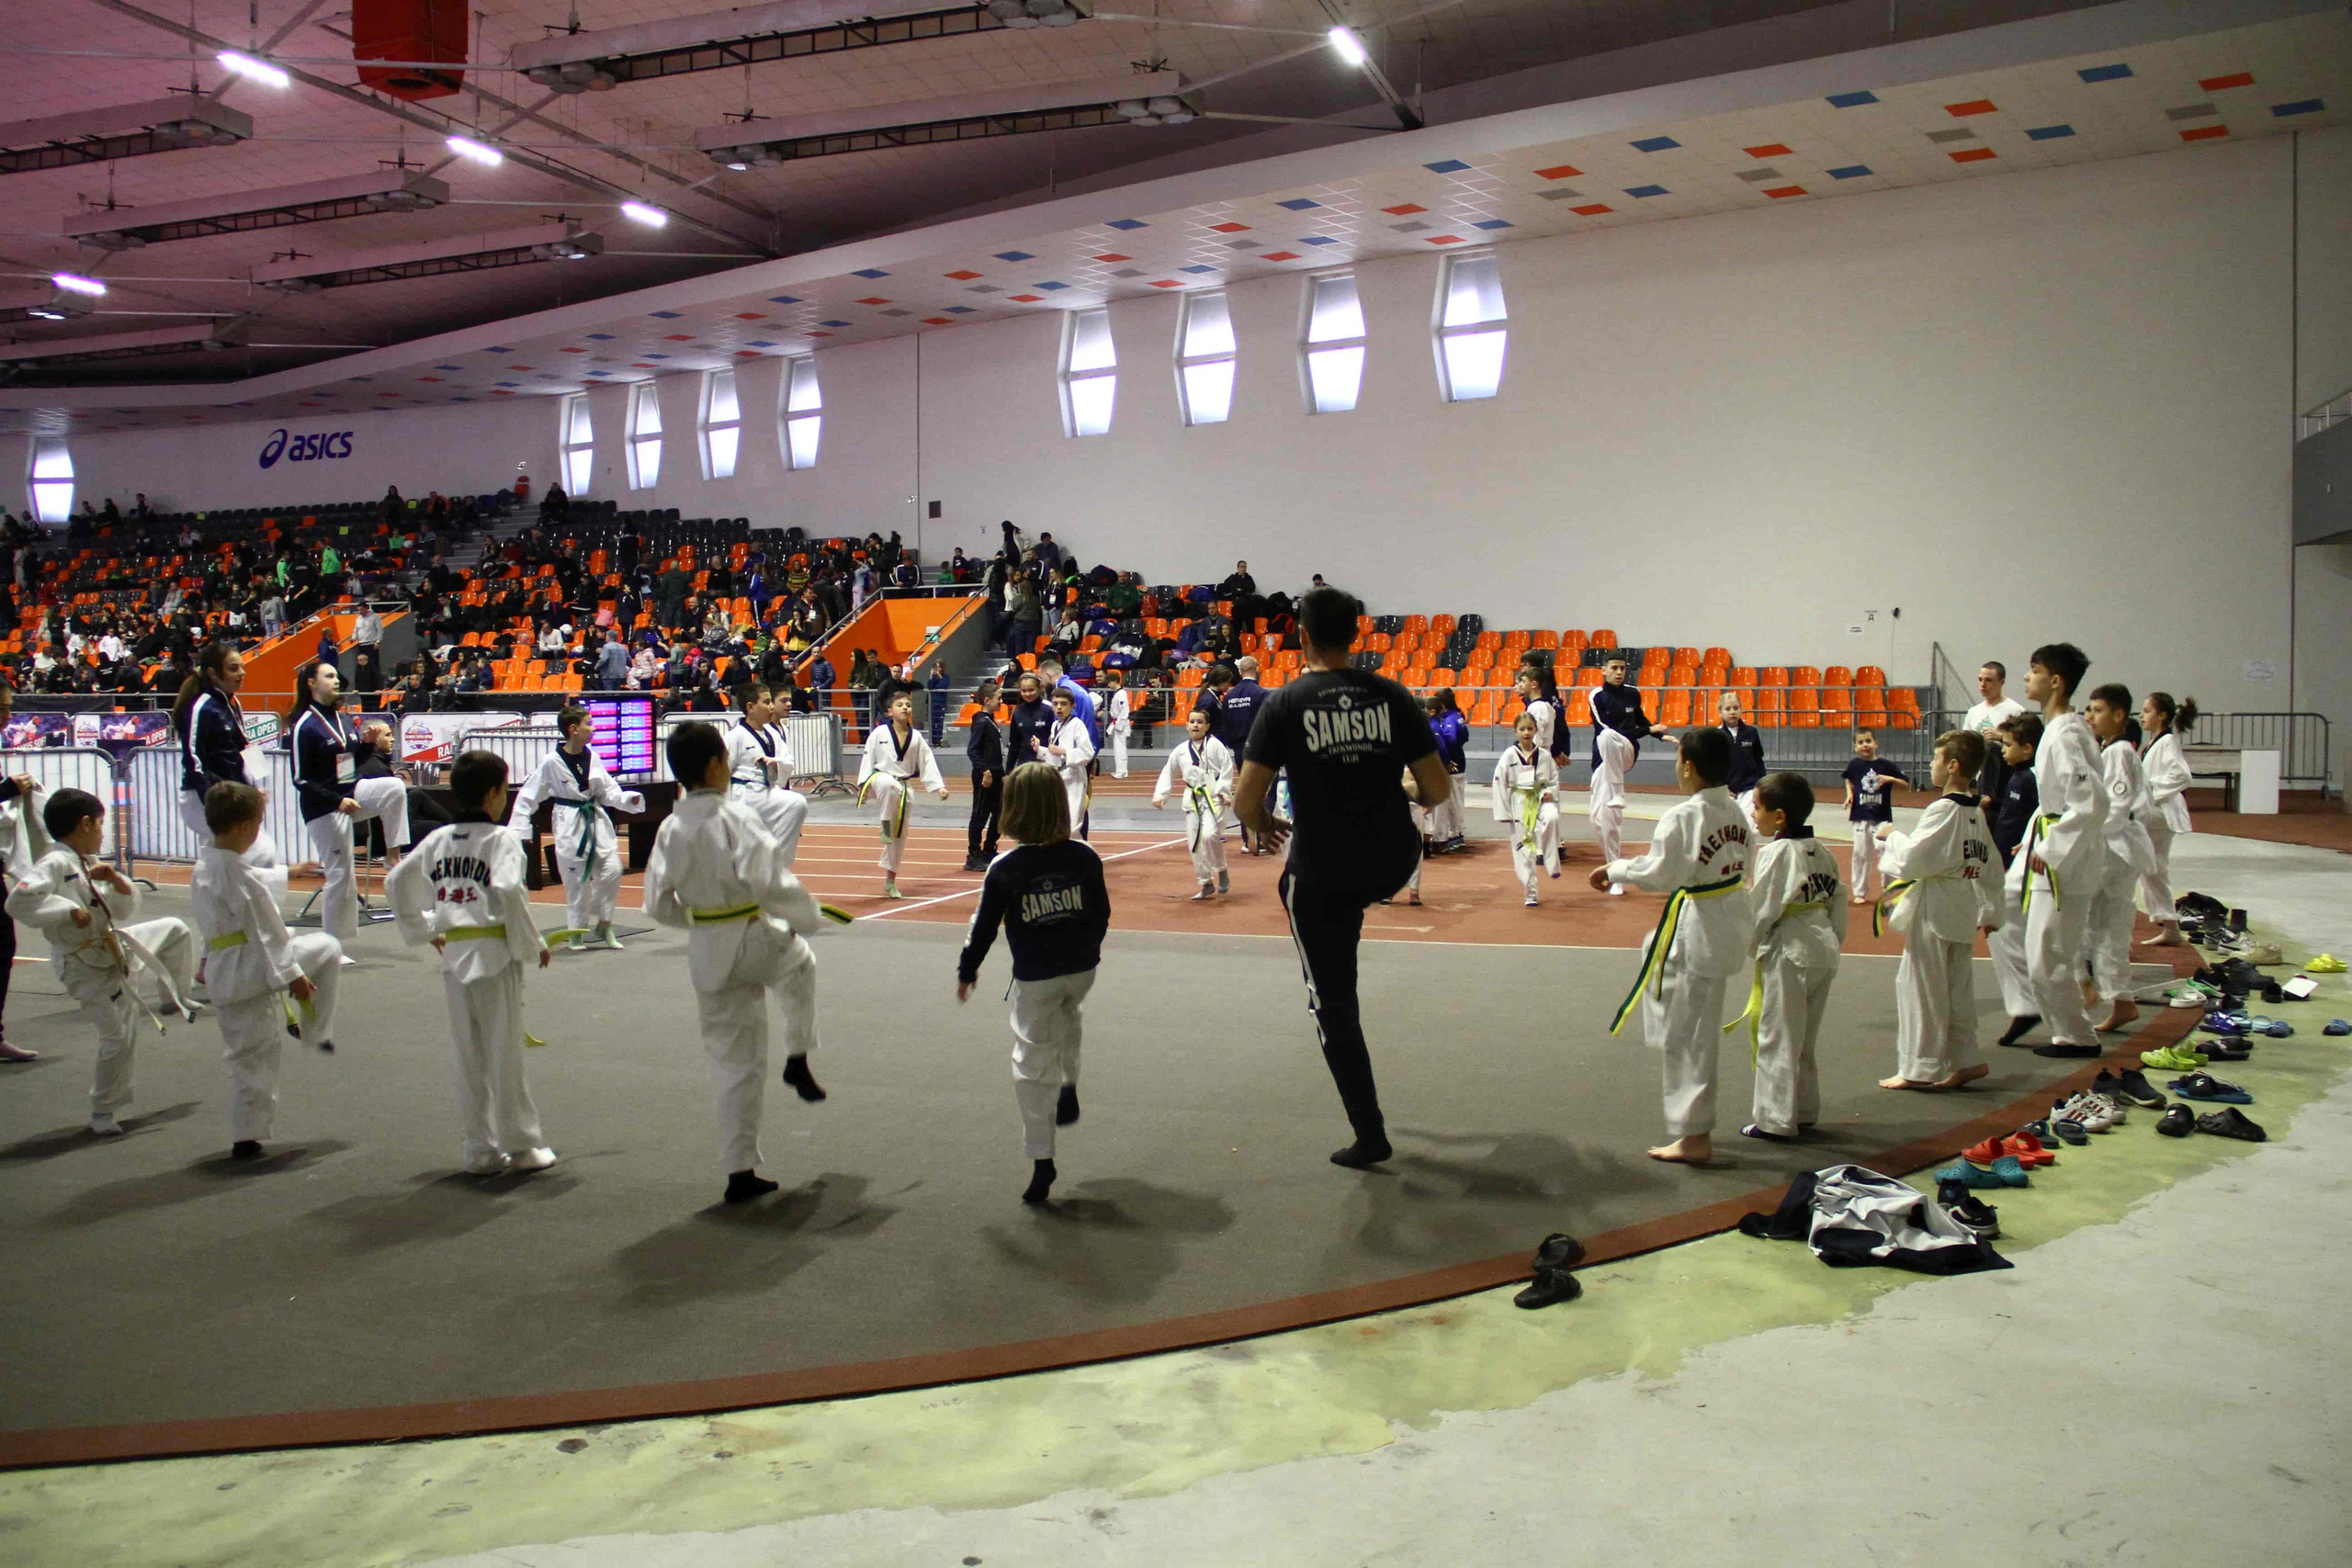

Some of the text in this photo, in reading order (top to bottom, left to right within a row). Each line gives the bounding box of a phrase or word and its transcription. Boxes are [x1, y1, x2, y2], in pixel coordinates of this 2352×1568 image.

[257, 720, 277, 737] OPEN
[1303, 701, 1391, 753] SAMSON
[1022, 885, 1083, 923] SAMSON
